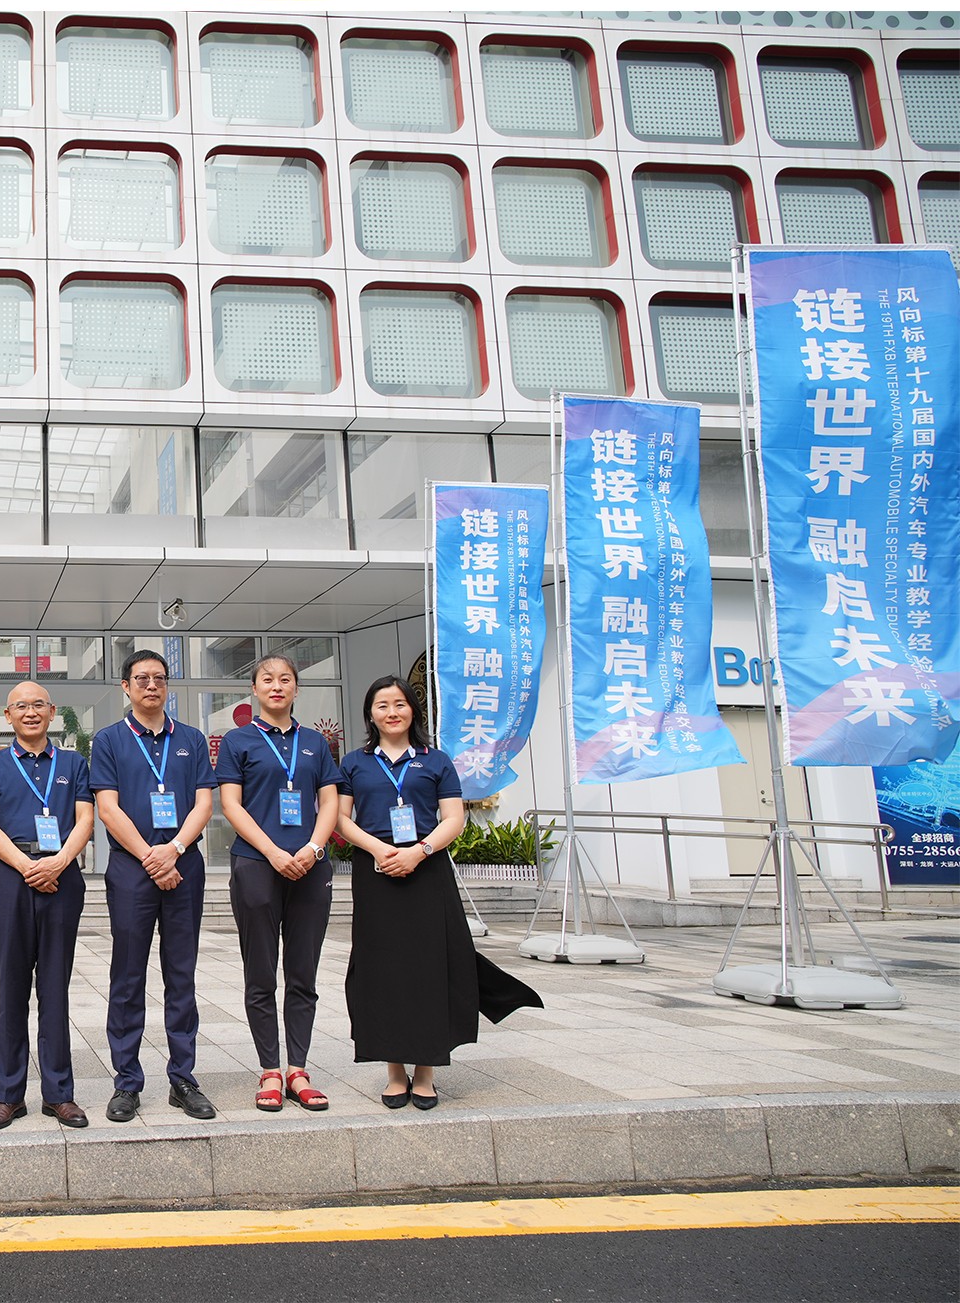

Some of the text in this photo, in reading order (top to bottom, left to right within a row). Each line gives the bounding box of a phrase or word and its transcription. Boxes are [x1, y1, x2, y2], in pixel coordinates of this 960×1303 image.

[877, 289, 891, 309] THE
[880, 312, 894, 338] 19TH
[882, 339, 897, 361] FXB
[884, 362, 906, 453] INTERNATIONAL
[647, 432, 657, 449] THE
[647, 451, 655, 473] 19TH
[645, 473, 655, 490] FXB
[885, 455, 906, 534] AUTOMOBILE
[506, 509, 514, 523] THE
[791, 286, 917, 727] 链接世界 融启未来
[506, 557, 517, 613] INTERNATIONAL
[656, 552, 667, 611] AUTOMOBILE
[885, 537, 899, 603] SPECIALTY
[590, 428, 662, 760] 链接世界 融启未来
[459, 507, 504, 780] 链接世界 融启未来
[508, 614, 519, 660] AUTOMOBILE
[656, 613, 667, 662] SPECIALTY
[509, 661, 519, 702] SPECIALTY
[911, 832, 955, 843] 全球招商
